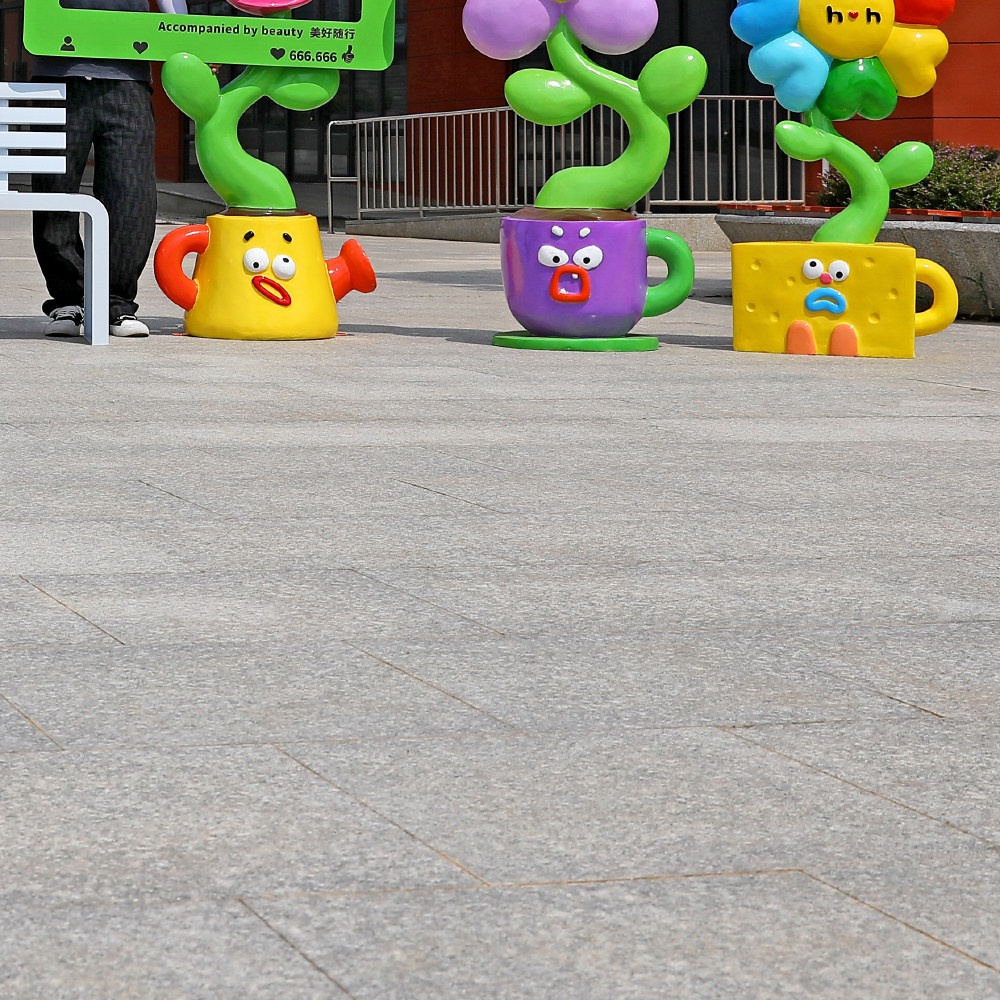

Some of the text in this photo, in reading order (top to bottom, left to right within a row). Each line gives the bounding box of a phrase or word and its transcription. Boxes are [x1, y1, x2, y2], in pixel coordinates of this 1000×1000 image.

[158, 21, 355, 40] Accompanied by beauty 美好随行
[289, 50, 337, 63] 666.666
